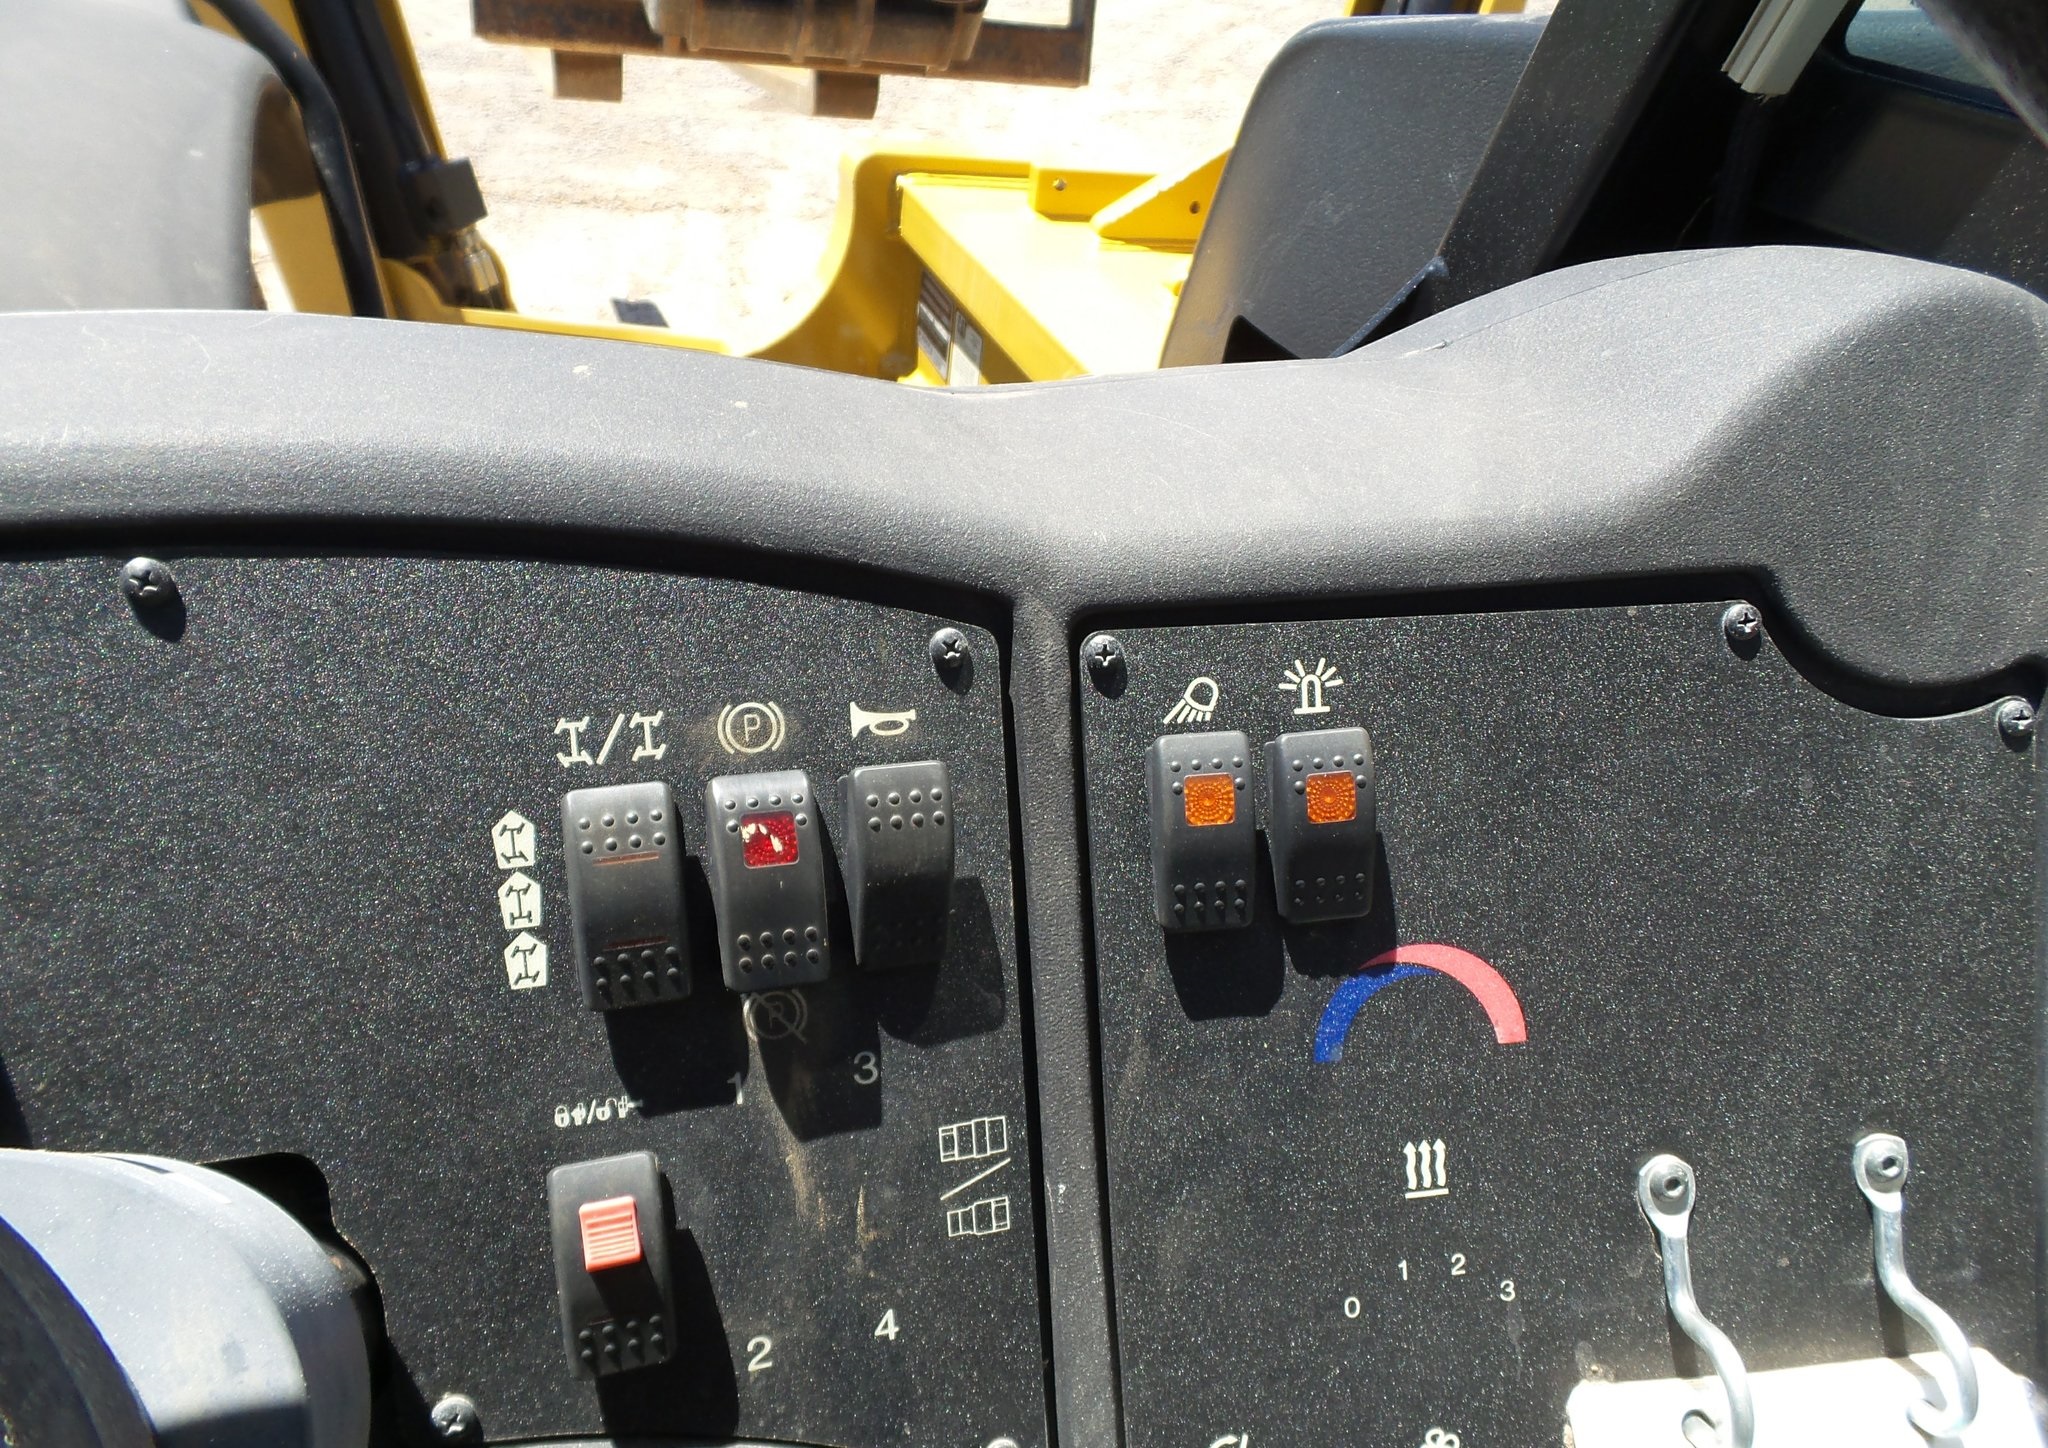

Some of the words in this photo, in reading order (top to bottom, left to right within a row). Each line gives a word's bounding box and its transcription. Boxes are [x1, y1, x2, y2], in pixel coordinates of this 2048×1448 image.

[743, 713, 761, 742] P
[853, 1051, 879, 1085] 3
[726, 1071, 744, 1105] 1
[1398, 1259, 1408, 1281] 1
[1451, 1253, 1466, 1276] 2
[1500, 1279, 1516, 1302] 3
[1344, 1296, 1361, 1319] 0
[873, 1308, 900, 1341] 4
[746, 1336, 773, 1372] 2
